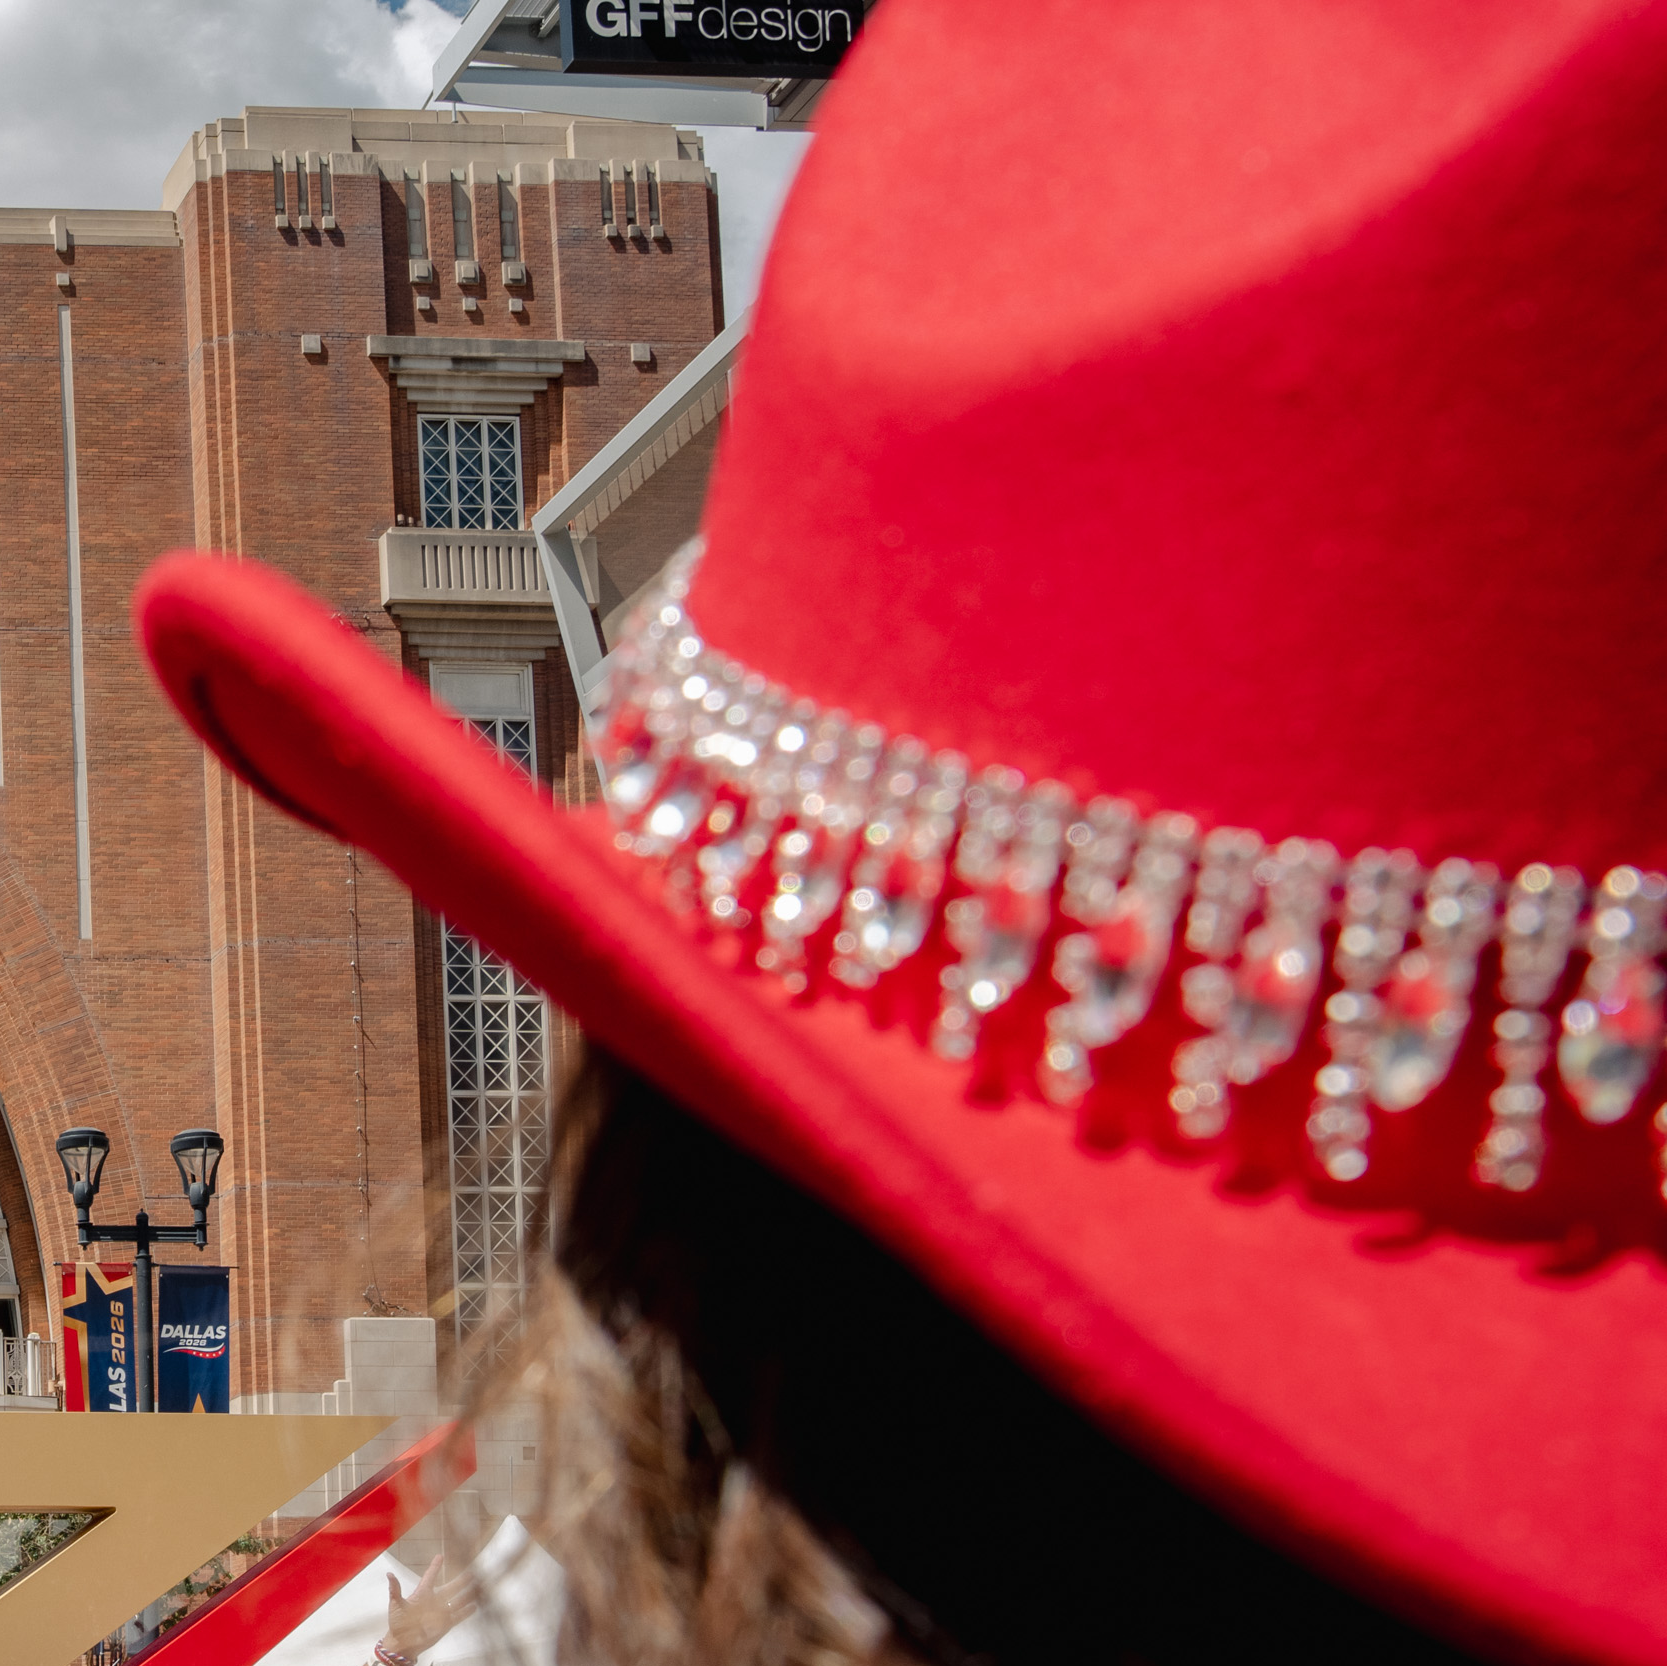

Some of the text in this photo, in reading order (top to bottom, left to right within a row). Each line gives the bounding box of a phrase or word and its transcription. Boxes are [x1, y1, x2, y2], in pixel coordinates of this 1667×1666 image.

[107, 1300, 127, 1413] LAS 2026
[160, 1324, 227, 1340] DALLAS
